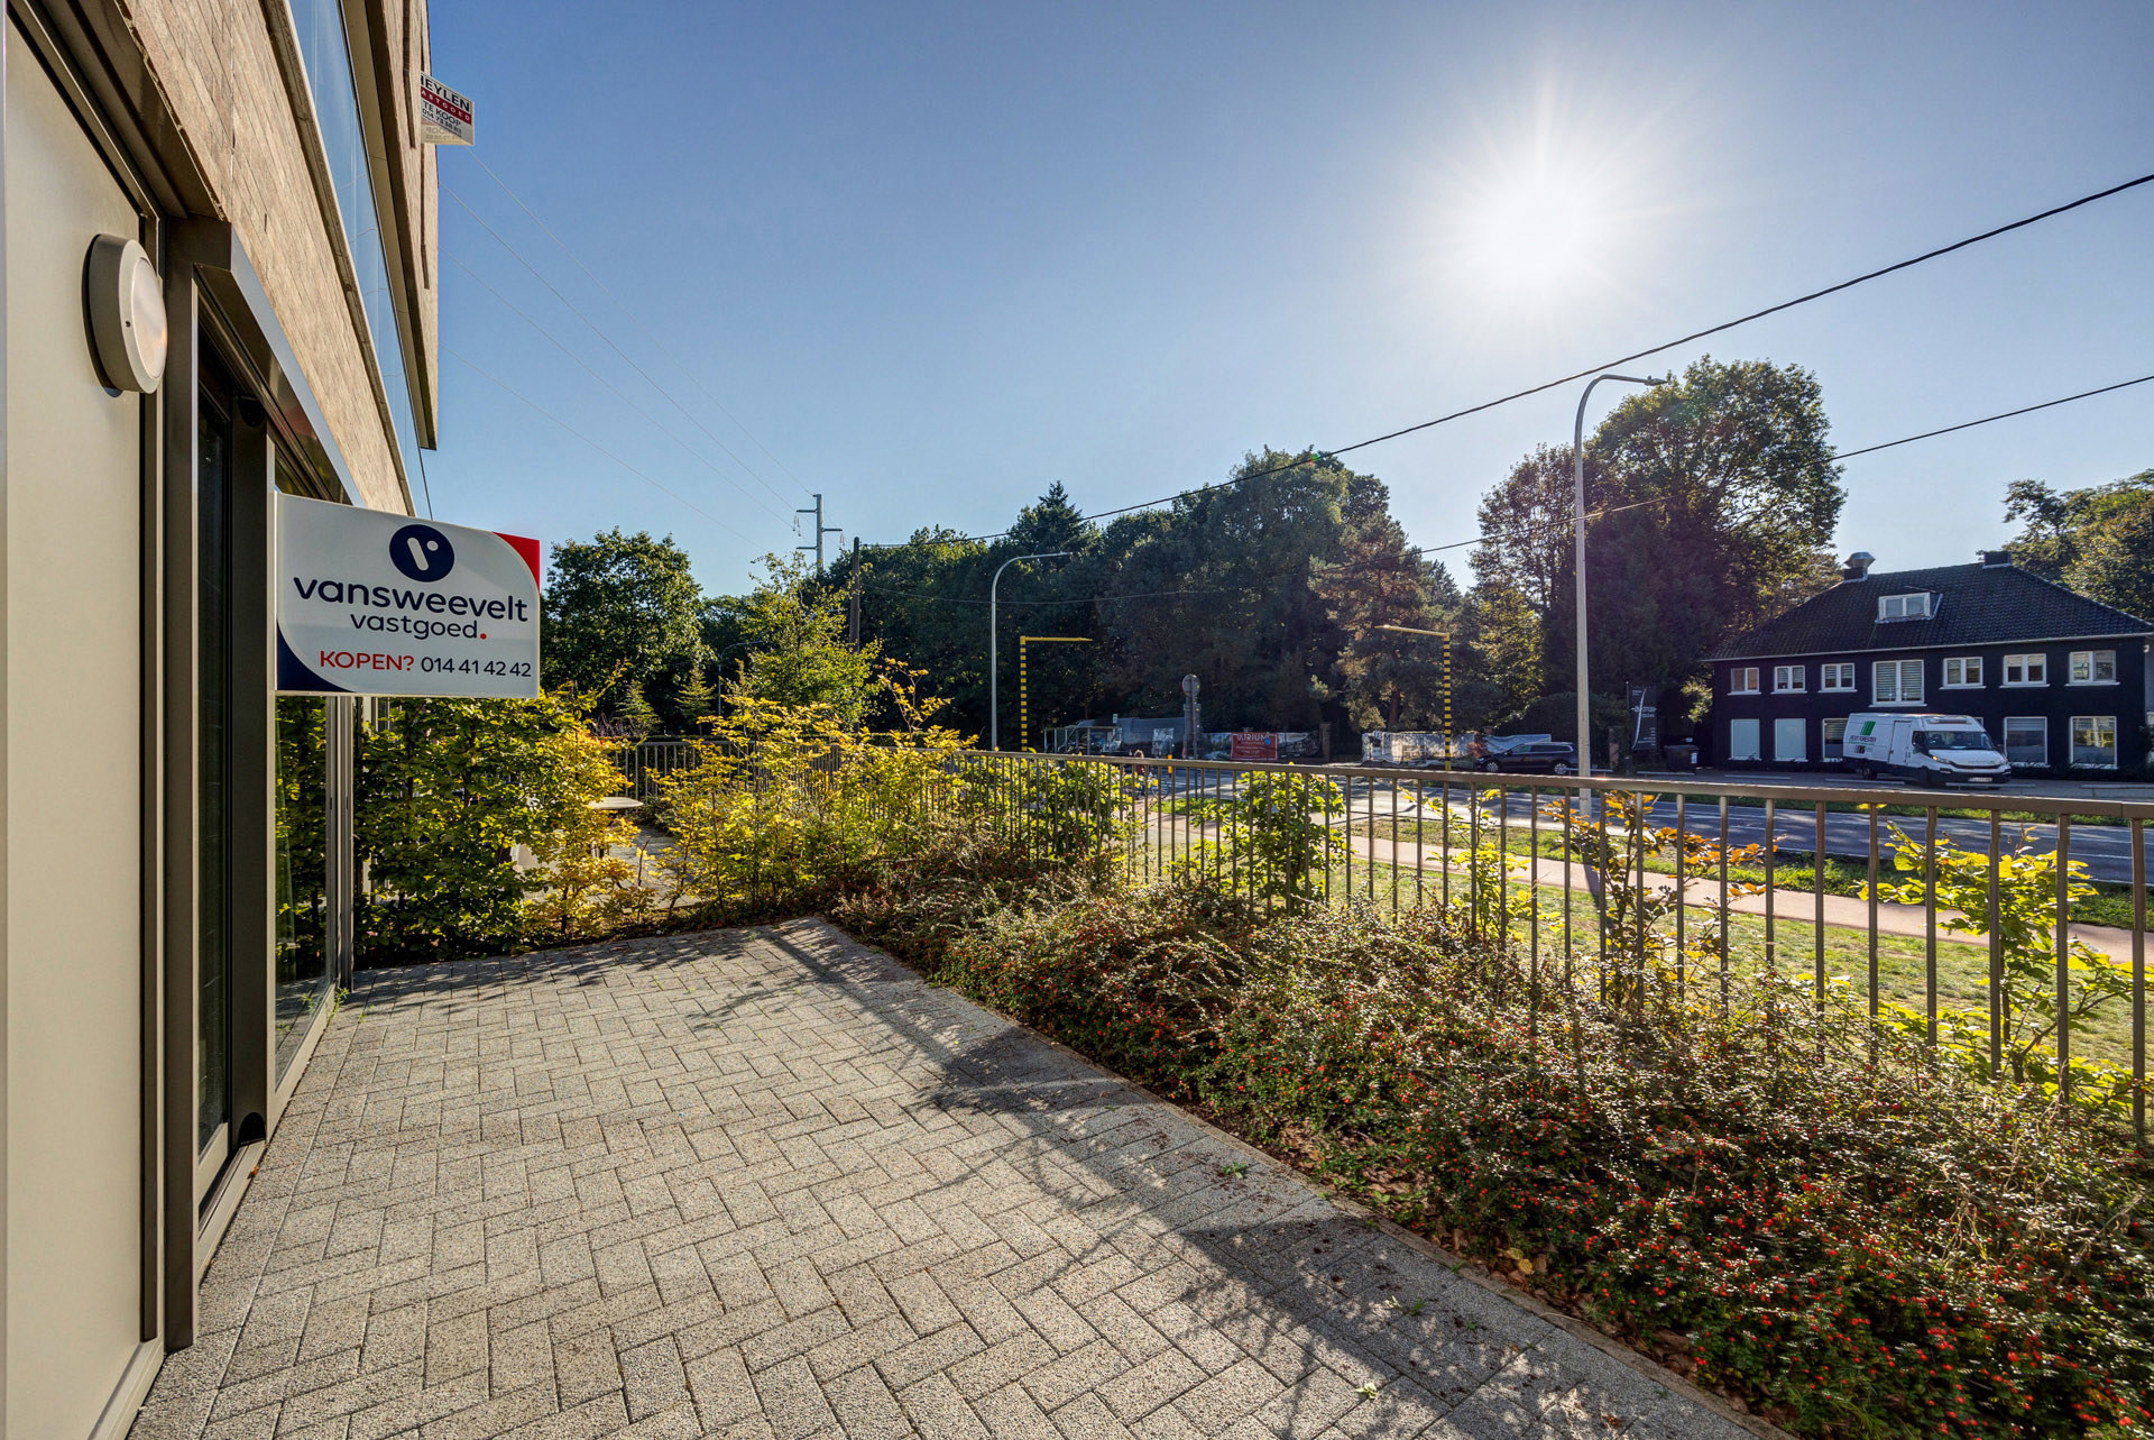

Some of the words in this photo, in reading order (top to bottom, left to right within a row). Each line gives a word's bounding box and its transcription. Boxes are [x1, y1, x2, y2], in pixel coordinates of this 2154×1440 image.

[421, 90, 470, 121] ASTGOED
[423, 100, 434, 113] TE
[435, 108, 461, 126] KOOP
[293, 576, 528, 622] vansweevelt
[350, 613, 487, 640] vastgoed.
[320, 650, 415, 671] KOPEN?
[421, 656, 455, 674] 014
[458, 659, 479, 675] 41
[483, 660, 506, 676] 42
[509, 662, 532, 677] 42
